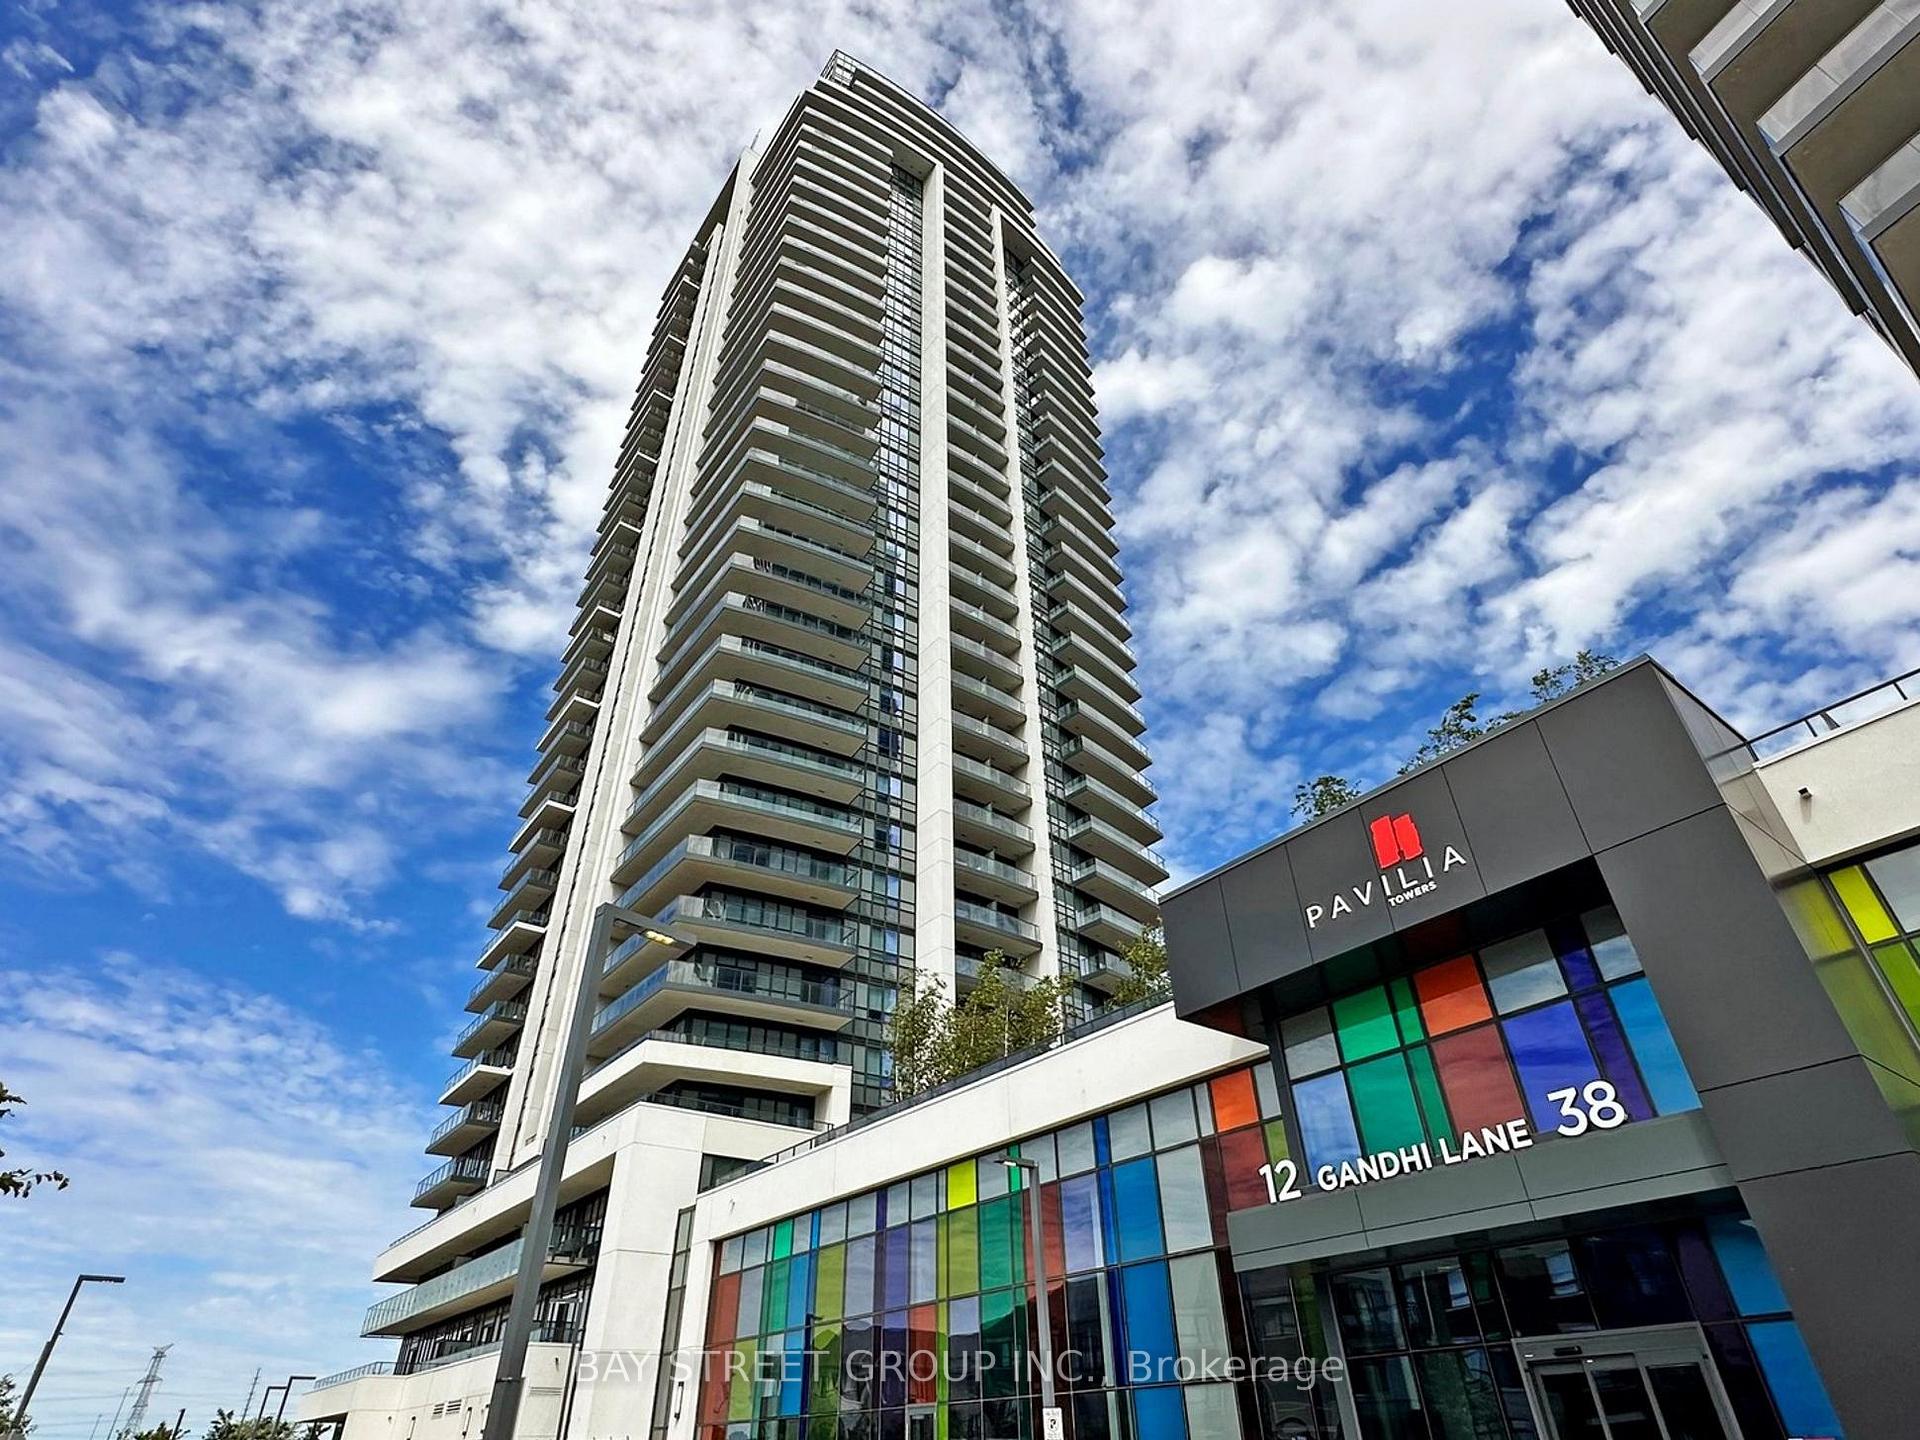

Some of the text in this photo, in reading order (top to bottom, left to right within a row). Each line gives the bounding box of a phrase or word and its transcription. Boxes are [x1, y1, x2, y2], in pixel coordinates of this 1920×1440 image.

[1306, 845, 1467, 929] PAVILIA
[1388, 880, 1438, 907] TOWERS
[1258, 1080, 1627, 1203] 12 GANDHI LANE 38
